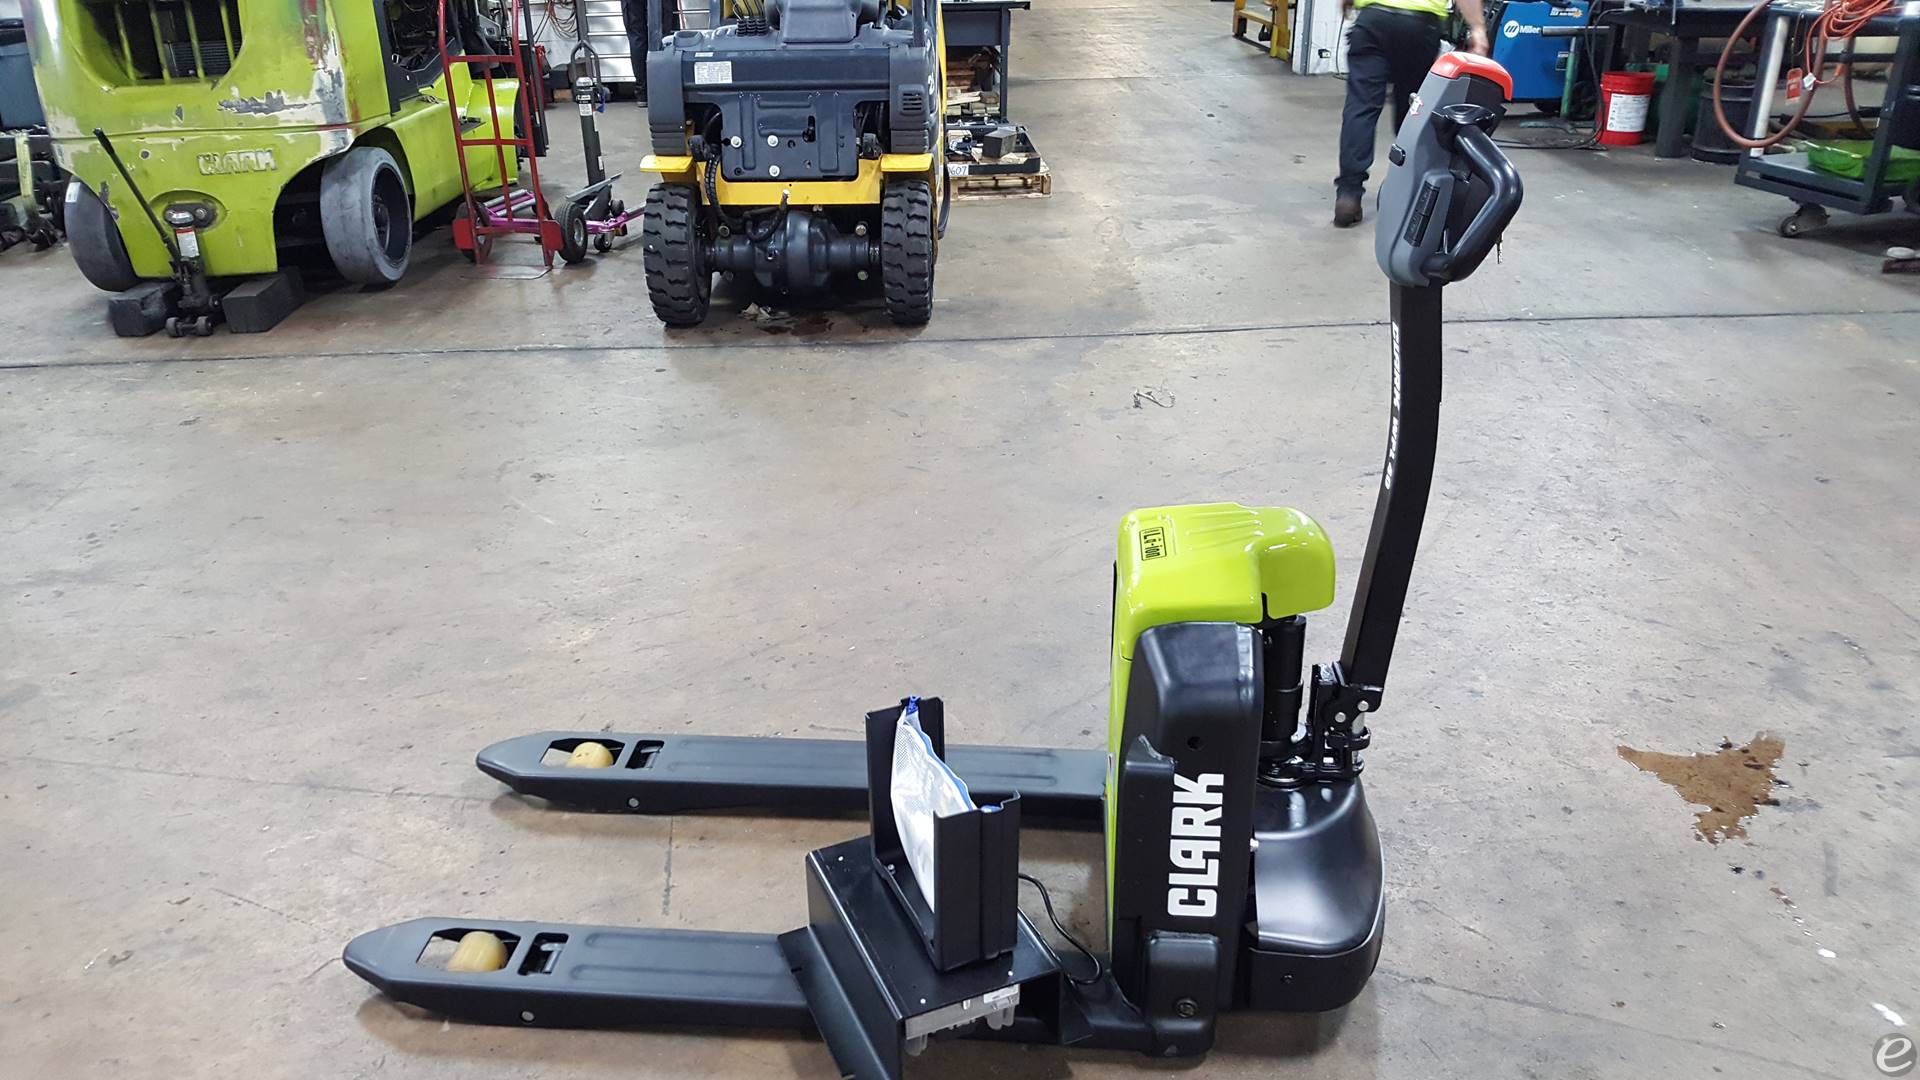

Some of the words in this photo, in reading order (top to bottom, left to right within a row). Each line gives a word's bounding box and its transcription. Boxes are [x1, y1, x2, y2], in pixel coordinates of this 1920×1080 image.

[1519, 25, 1541, 34] Miller
[1392, 321, 1401, 411] CLARK
[1143, 532, 1162, 559] Li-ion
[1167, 773, 1224, 918] CLARK
